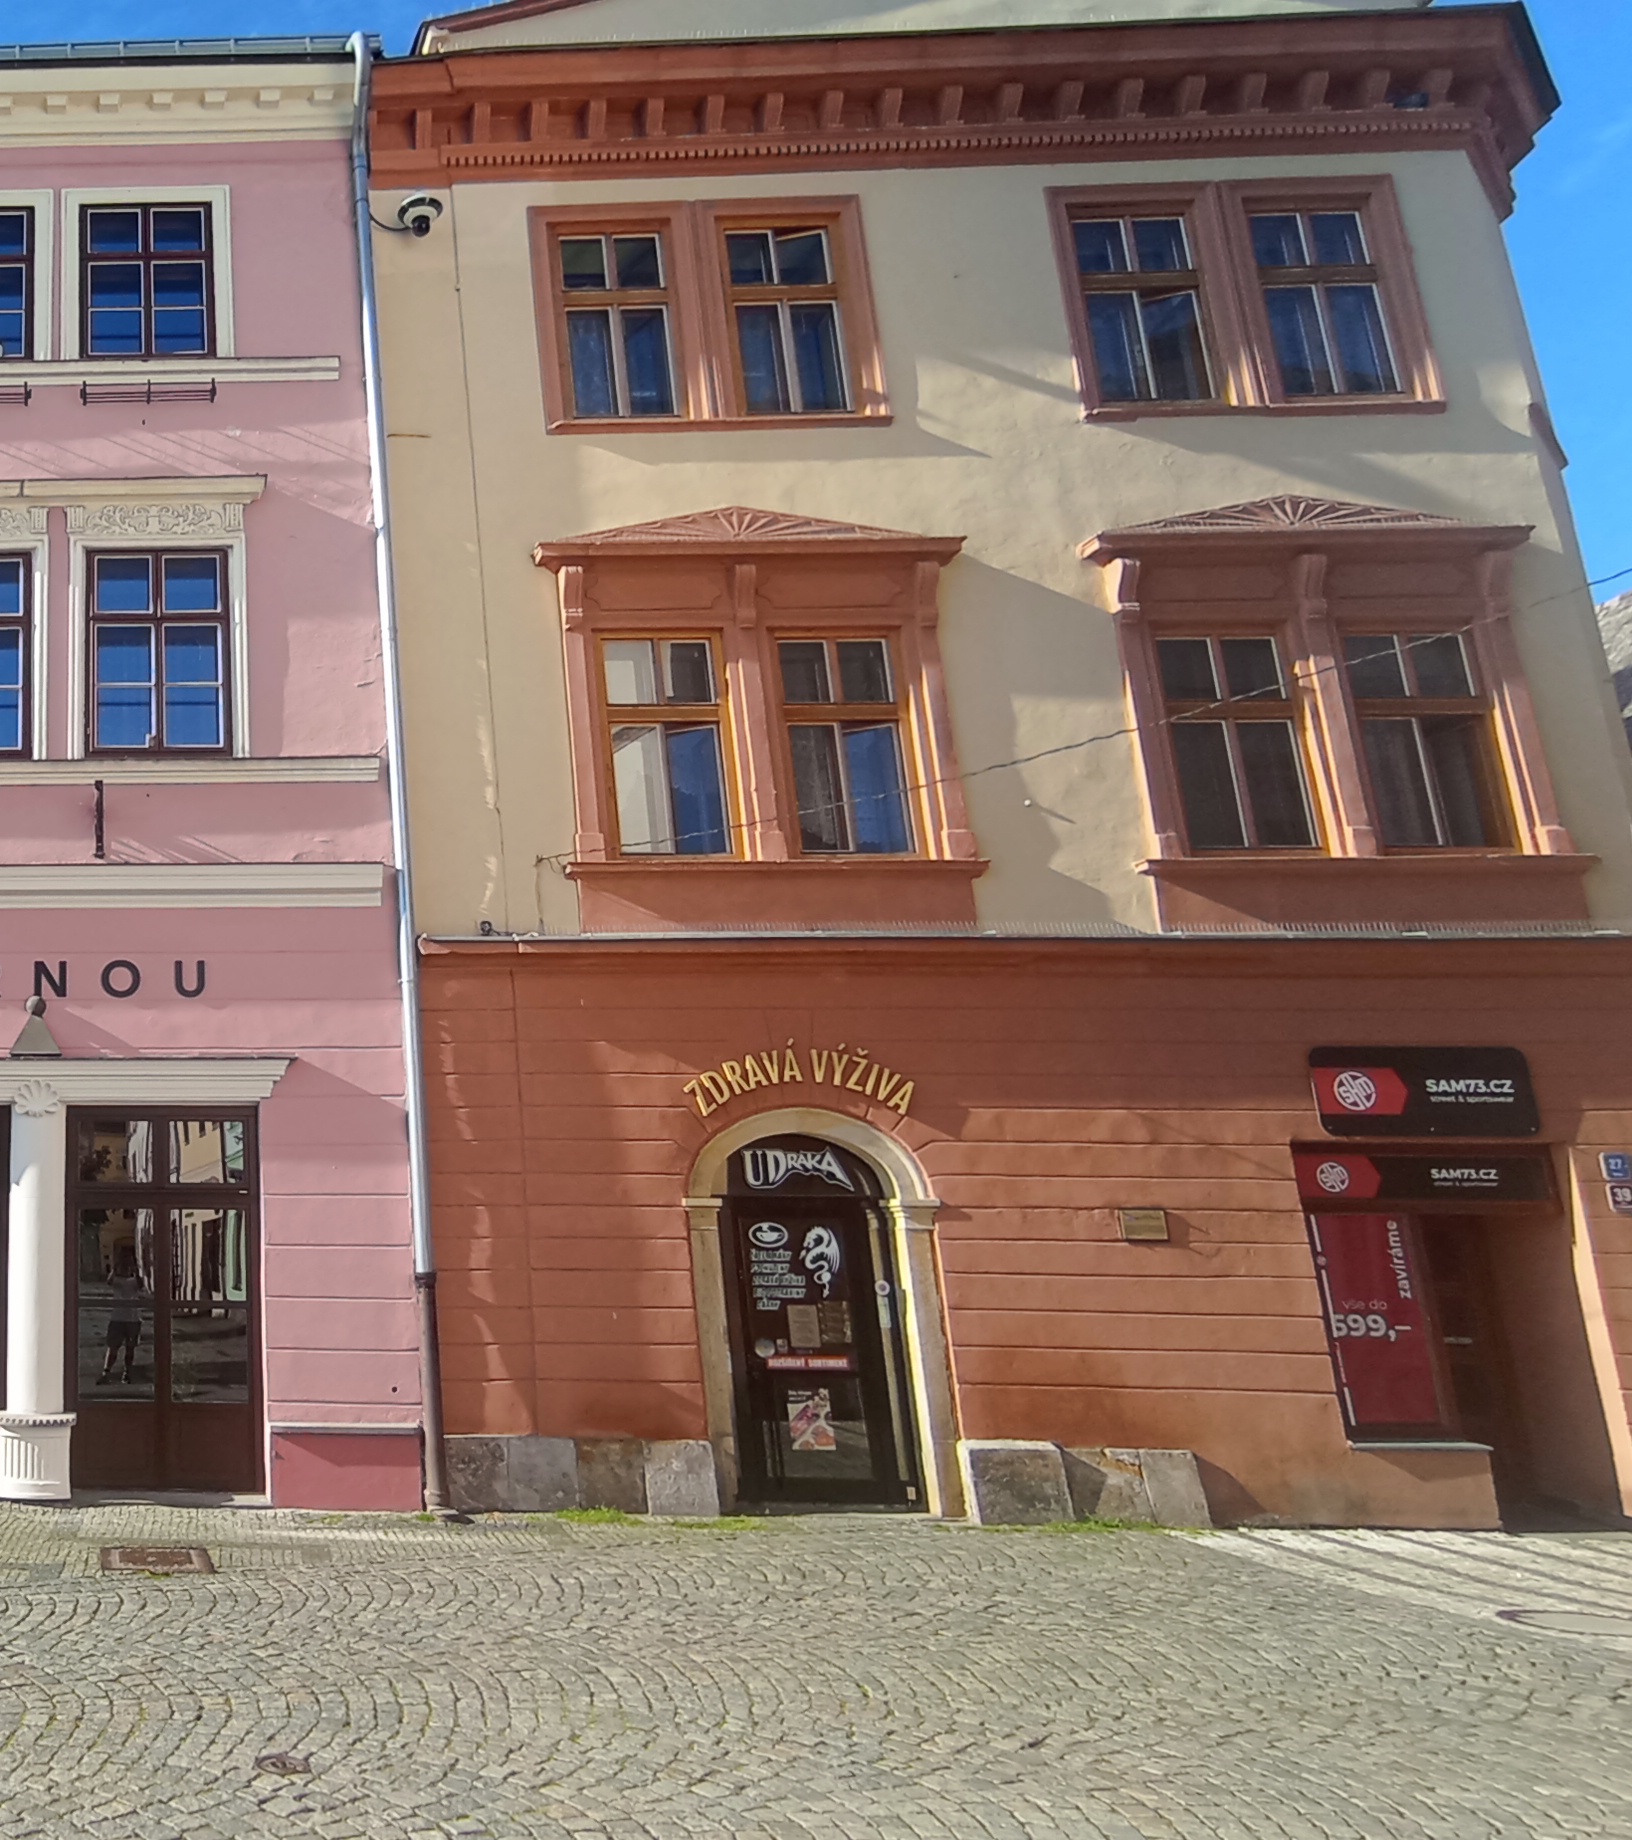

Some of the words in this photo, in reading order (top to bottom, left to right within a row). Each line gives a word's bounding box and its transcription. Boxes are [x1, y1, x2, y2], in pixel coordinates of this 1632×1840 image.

[682, 1038, 803, 1117] ZDRAVÁ
[810, 1043, 915, 1115] VÝŽIVA
[1425, 1079, 1515, 1094] SAM73.CZ
[1430, 1168, 1499, 1180] SAM73.CZ
[1613, 1187, 1632, 1202] 39
[1386, 1219, 1412, 1300] zavíráme
[1369, 1298, 1388, 1310] do
